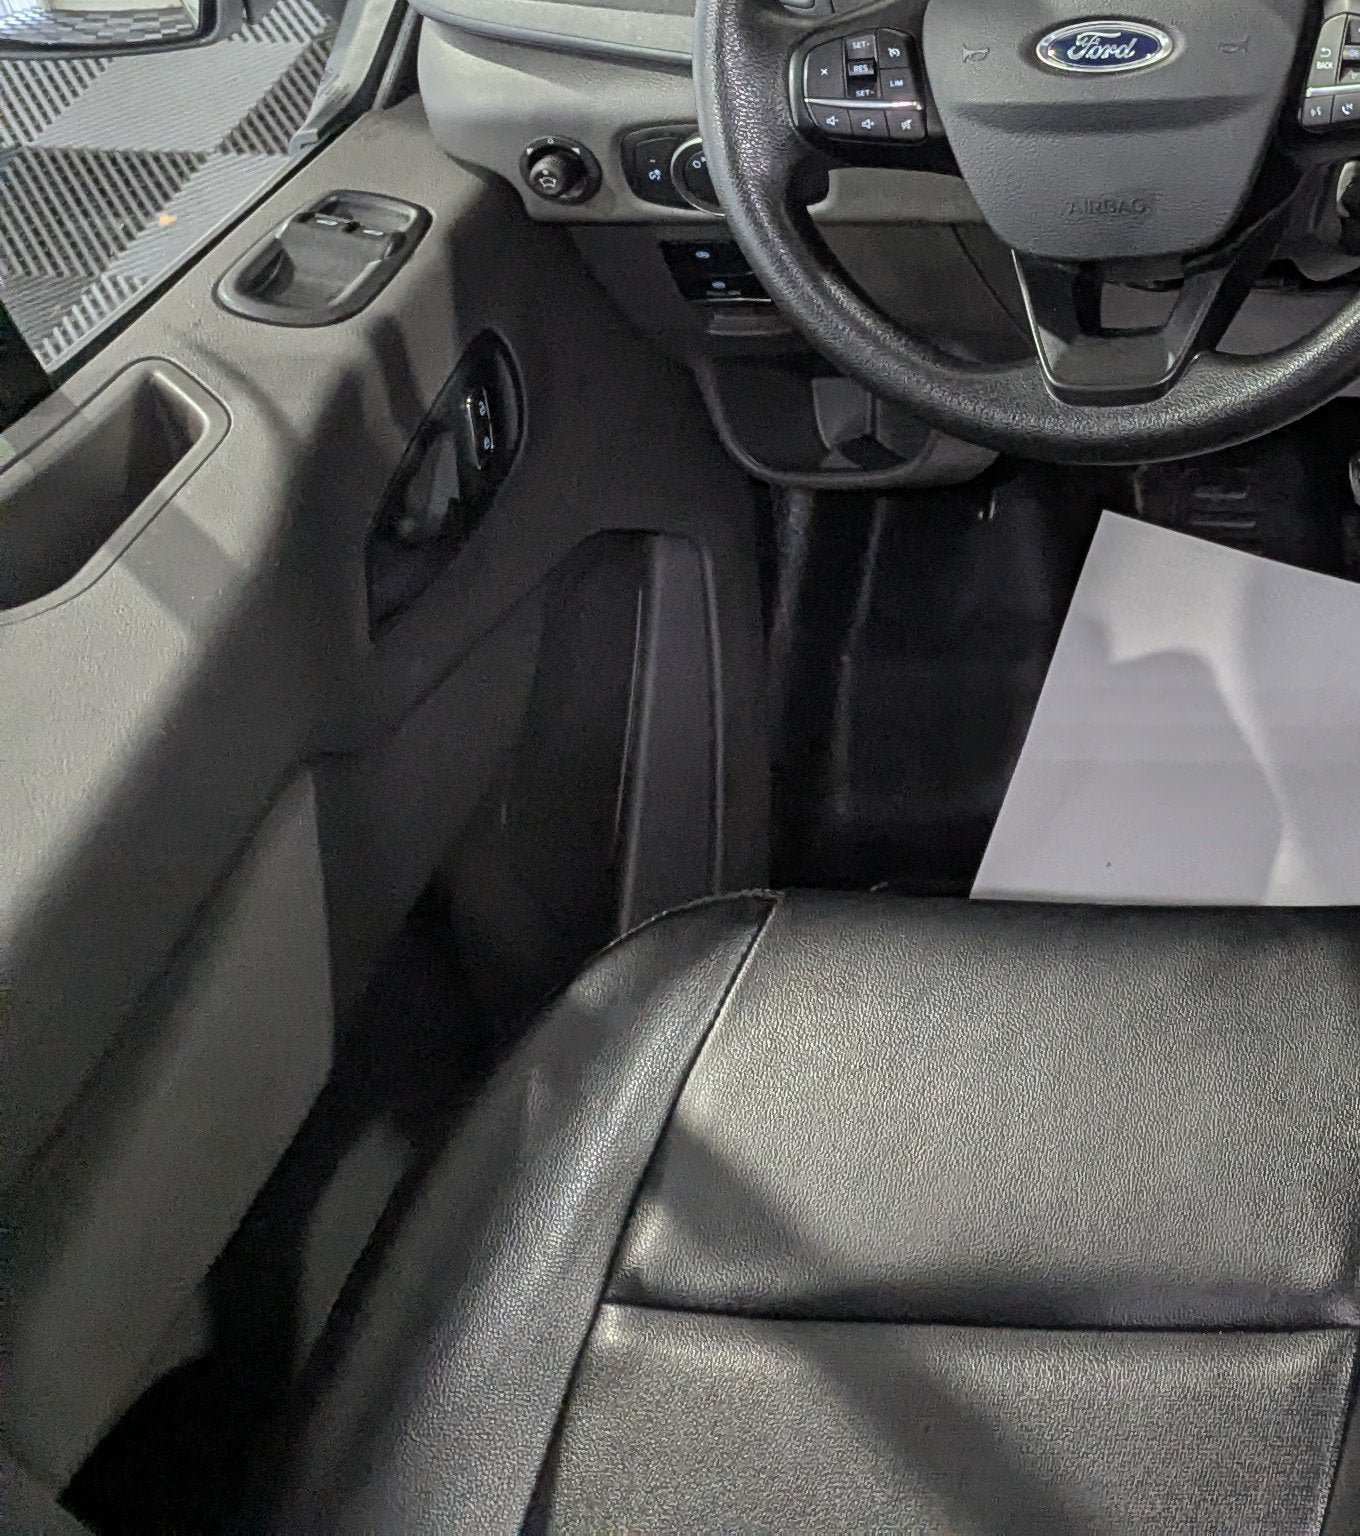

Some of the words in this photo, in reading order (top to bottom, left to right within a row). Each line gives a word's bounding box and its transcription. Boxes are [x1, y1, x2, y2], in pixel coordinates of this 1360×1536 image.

[1066, 31, 1138, 61] Ford
[853, 64, 869, 73] RES
[1316, 61, 1334, 70] BACK
[889, 79, 904, 88] LIM
